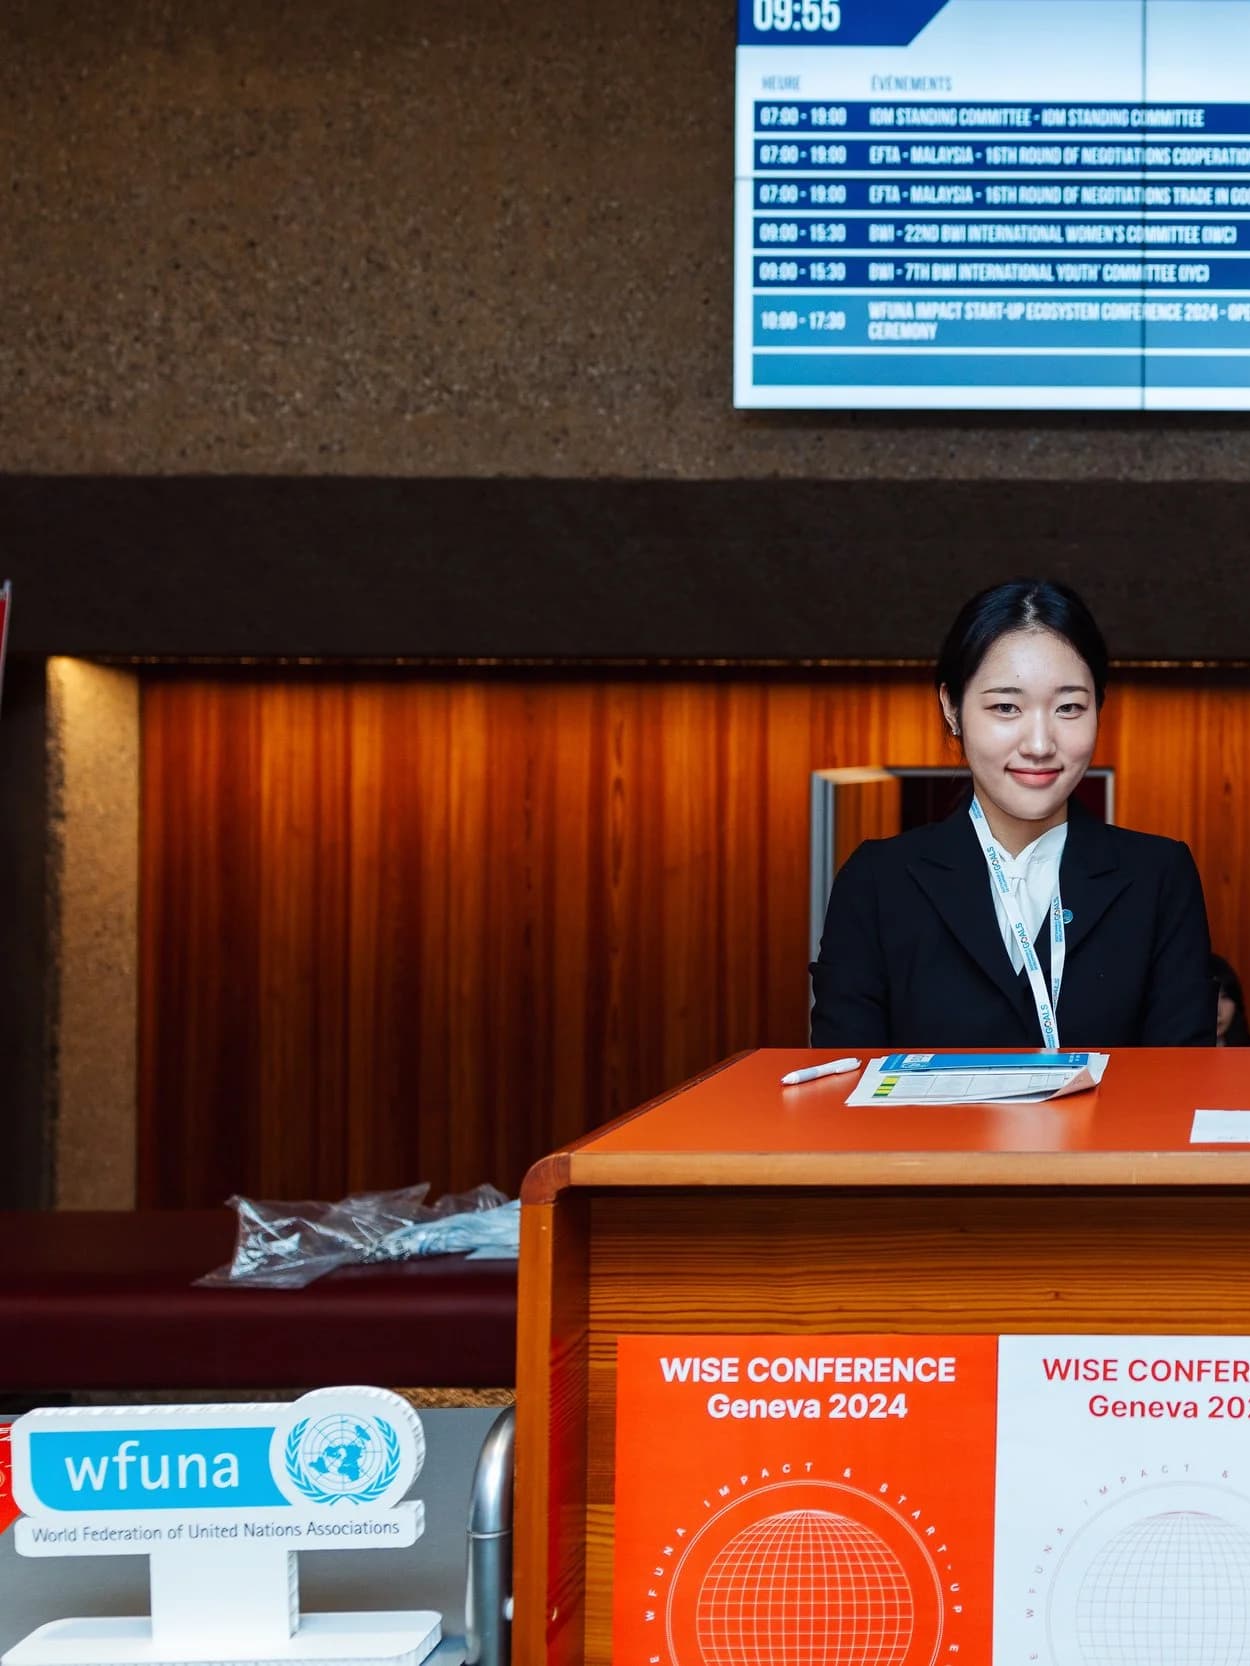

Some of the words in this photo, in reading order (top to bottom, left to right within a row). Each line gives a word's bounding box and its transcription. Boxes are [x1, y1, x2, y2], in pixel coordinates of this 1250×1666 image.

[753, 0, 841, 31] 09:55
[759, 107, 799, 127] 07:00
[810, 107, 847, 127] 19:00
[895, 107, 957, 127] STANDING
[958, 108, 1032, 127] COMMITTEE
[1067, 108, 1129, 127] STANDING
[1130, 108, 1205, 128] COMMITTEE
[759, 145, 799, 165] 07:00
[810, 145, 847, 165] 19:00
[868, 145, 900, 164] EFTA
[910, 146, 974, 164] MALAYSIA
[1018, 146, 1062, 165] ROUND
[1062, 147, 1080, 165] OF
[1081, 147, 1170, 166] NEGOTIATIONS
[759, 184, 799, 204] 07:00
[810, 184, 847, 204] 19:00
[868, 184, 900, 204] EFTA
[910, 185, 974, 204] MALAYSIA
[1018, 186, 1062, 204] ROUND
[1062, 186, 1080, 204] OF
[1081, 186, 1170, 205] NEGOTIATIONS
[1172, 186, 1213, 206] TRADE
[1214, 186, 1229, 206] IN
[759, 223, 799, 243] 09:00
[810, 223, 847, 243] 15:30
[967, 224, 1064, 243] INTERNATIONAL
[1064, 225, 1125, 243] WOMEN'S
[1126, 225, 1200, 244] COMMITTEE
[759, 262, 799, 282] 09:00
[810, 262, 847, 282] 15:30
[904, 262, 930, 281] 7TH
[958, 263, 1054, 282] INTERNATIONAL
[1102, 263, 1177, 283] COMMITTEE
[759, 311, 799, 331] 10:00
[810, 311, 847, 331] 17:30
[868, 301, 914, 320] WFUNA
[915, 301, 963, 320] IMPACT
[1025, 302, 1100, 320] ECOSYSTEM
[1101, 302, 1184, 321] CONFERENCE
[1184, 303, 1218, 321] 2024
[868, 322, 938, 341] CEREMONY
[1015, 922, 1030, 949] GOALS
[1040, 1003, 1053, 1034] GOALS
[660, 1357, 739, 1382] WISE
[747, 1357, 956, 1383] CONFERENCE
[1042, 1358, 1119, 1381] WISE
[707, 1393, 821, 1419] Geneva
[829, 1393, 908, 1419] 2024
[1088, 1394, 1198, 1418] Geneva
[65, 1440, 240, 1491] wfuna
[32, 1527, 77, 1543] World
[83, 1525, 162, 1542] Federation
[167, 1524, 184, 1540] of
[189, 1522, 238, 1539] United
[244, 1521, 302, 1537] Nations
[306, 1519, 400, 1536] Associations
[644, 1526, 687, 1622] WFUNA
[702, 1461, 813, 1508] IMPACT
